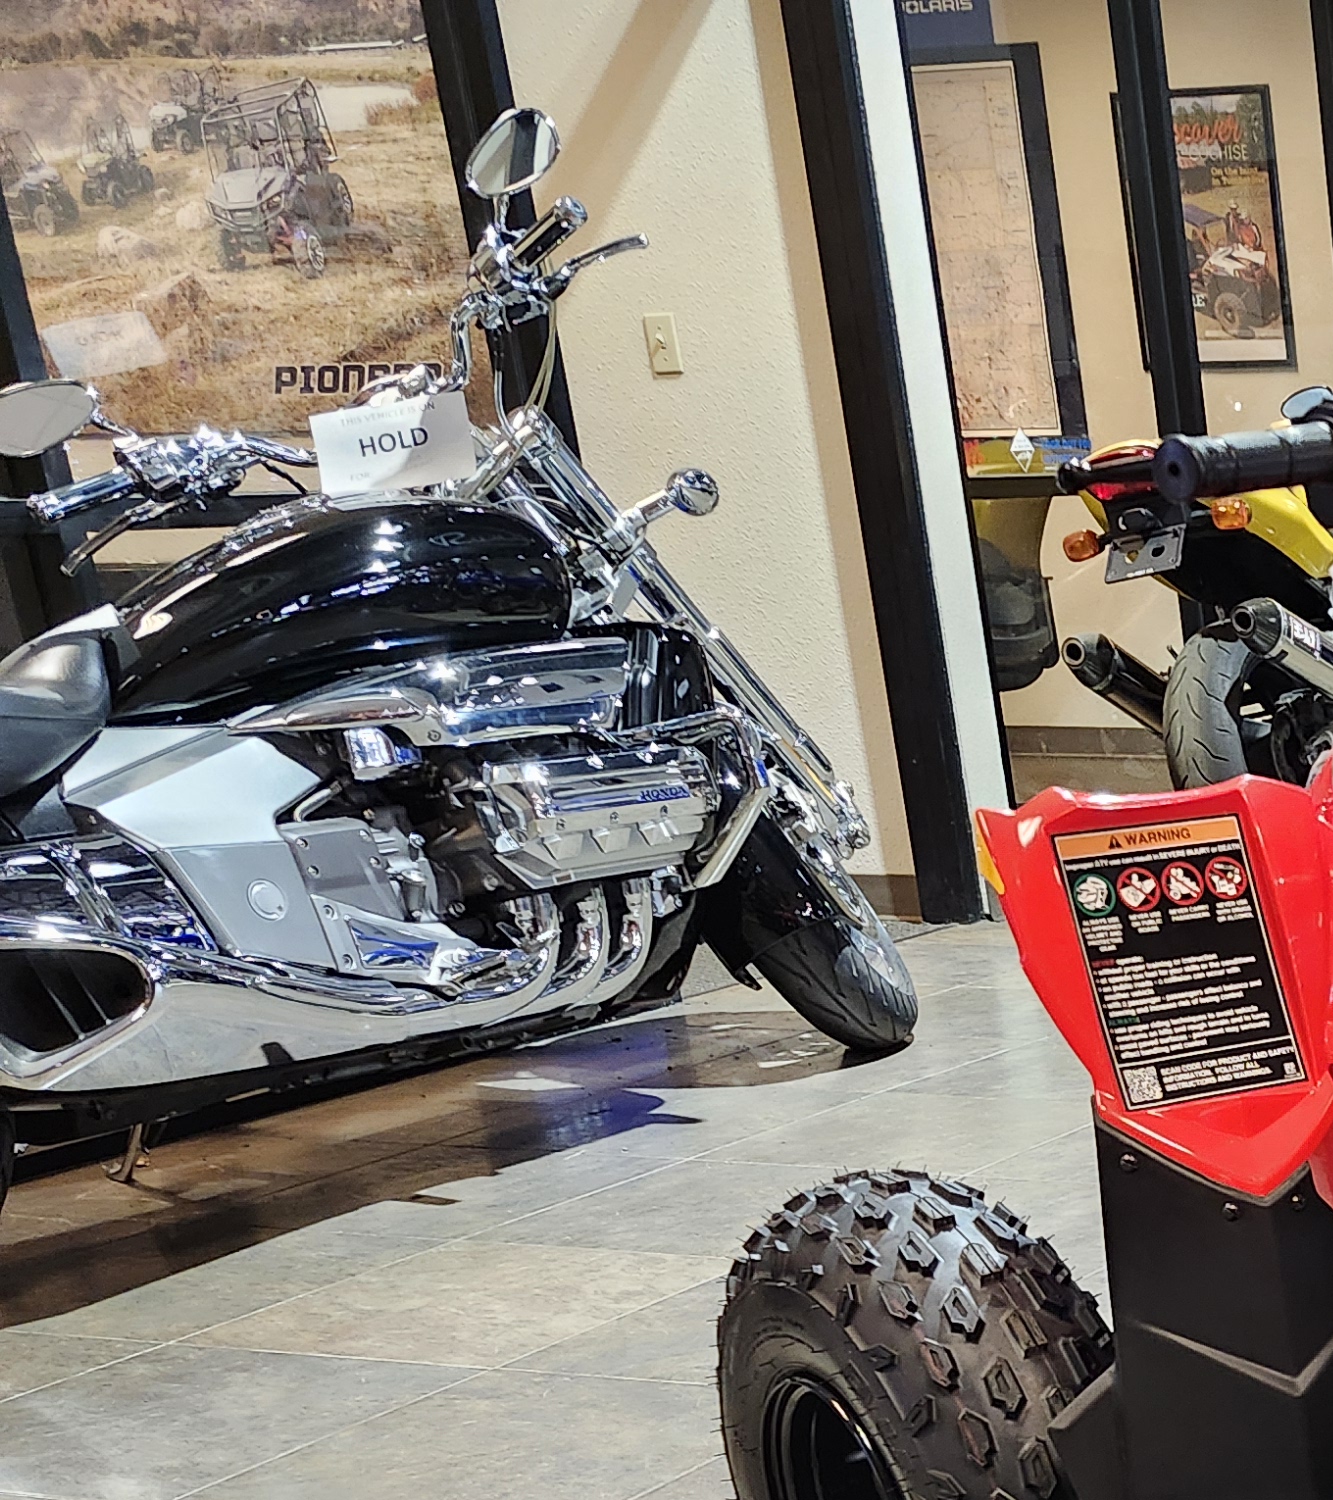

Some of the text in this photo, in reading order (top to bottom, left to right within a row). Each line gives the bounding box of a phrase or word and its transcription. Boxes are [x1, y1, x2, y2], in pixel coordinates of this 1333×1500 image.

[902, 0, 973, 14] OLARIS
[1174, 114, 1241, 146] scover
[275, 362, 444, 395] PIONE
[364, 409, 405, 423] VEHICLE
[359, 427, 428, 457] HOLD
[640, 785, 690, 800] HONDA
[1124, 828, 1191, 846] WARNING
